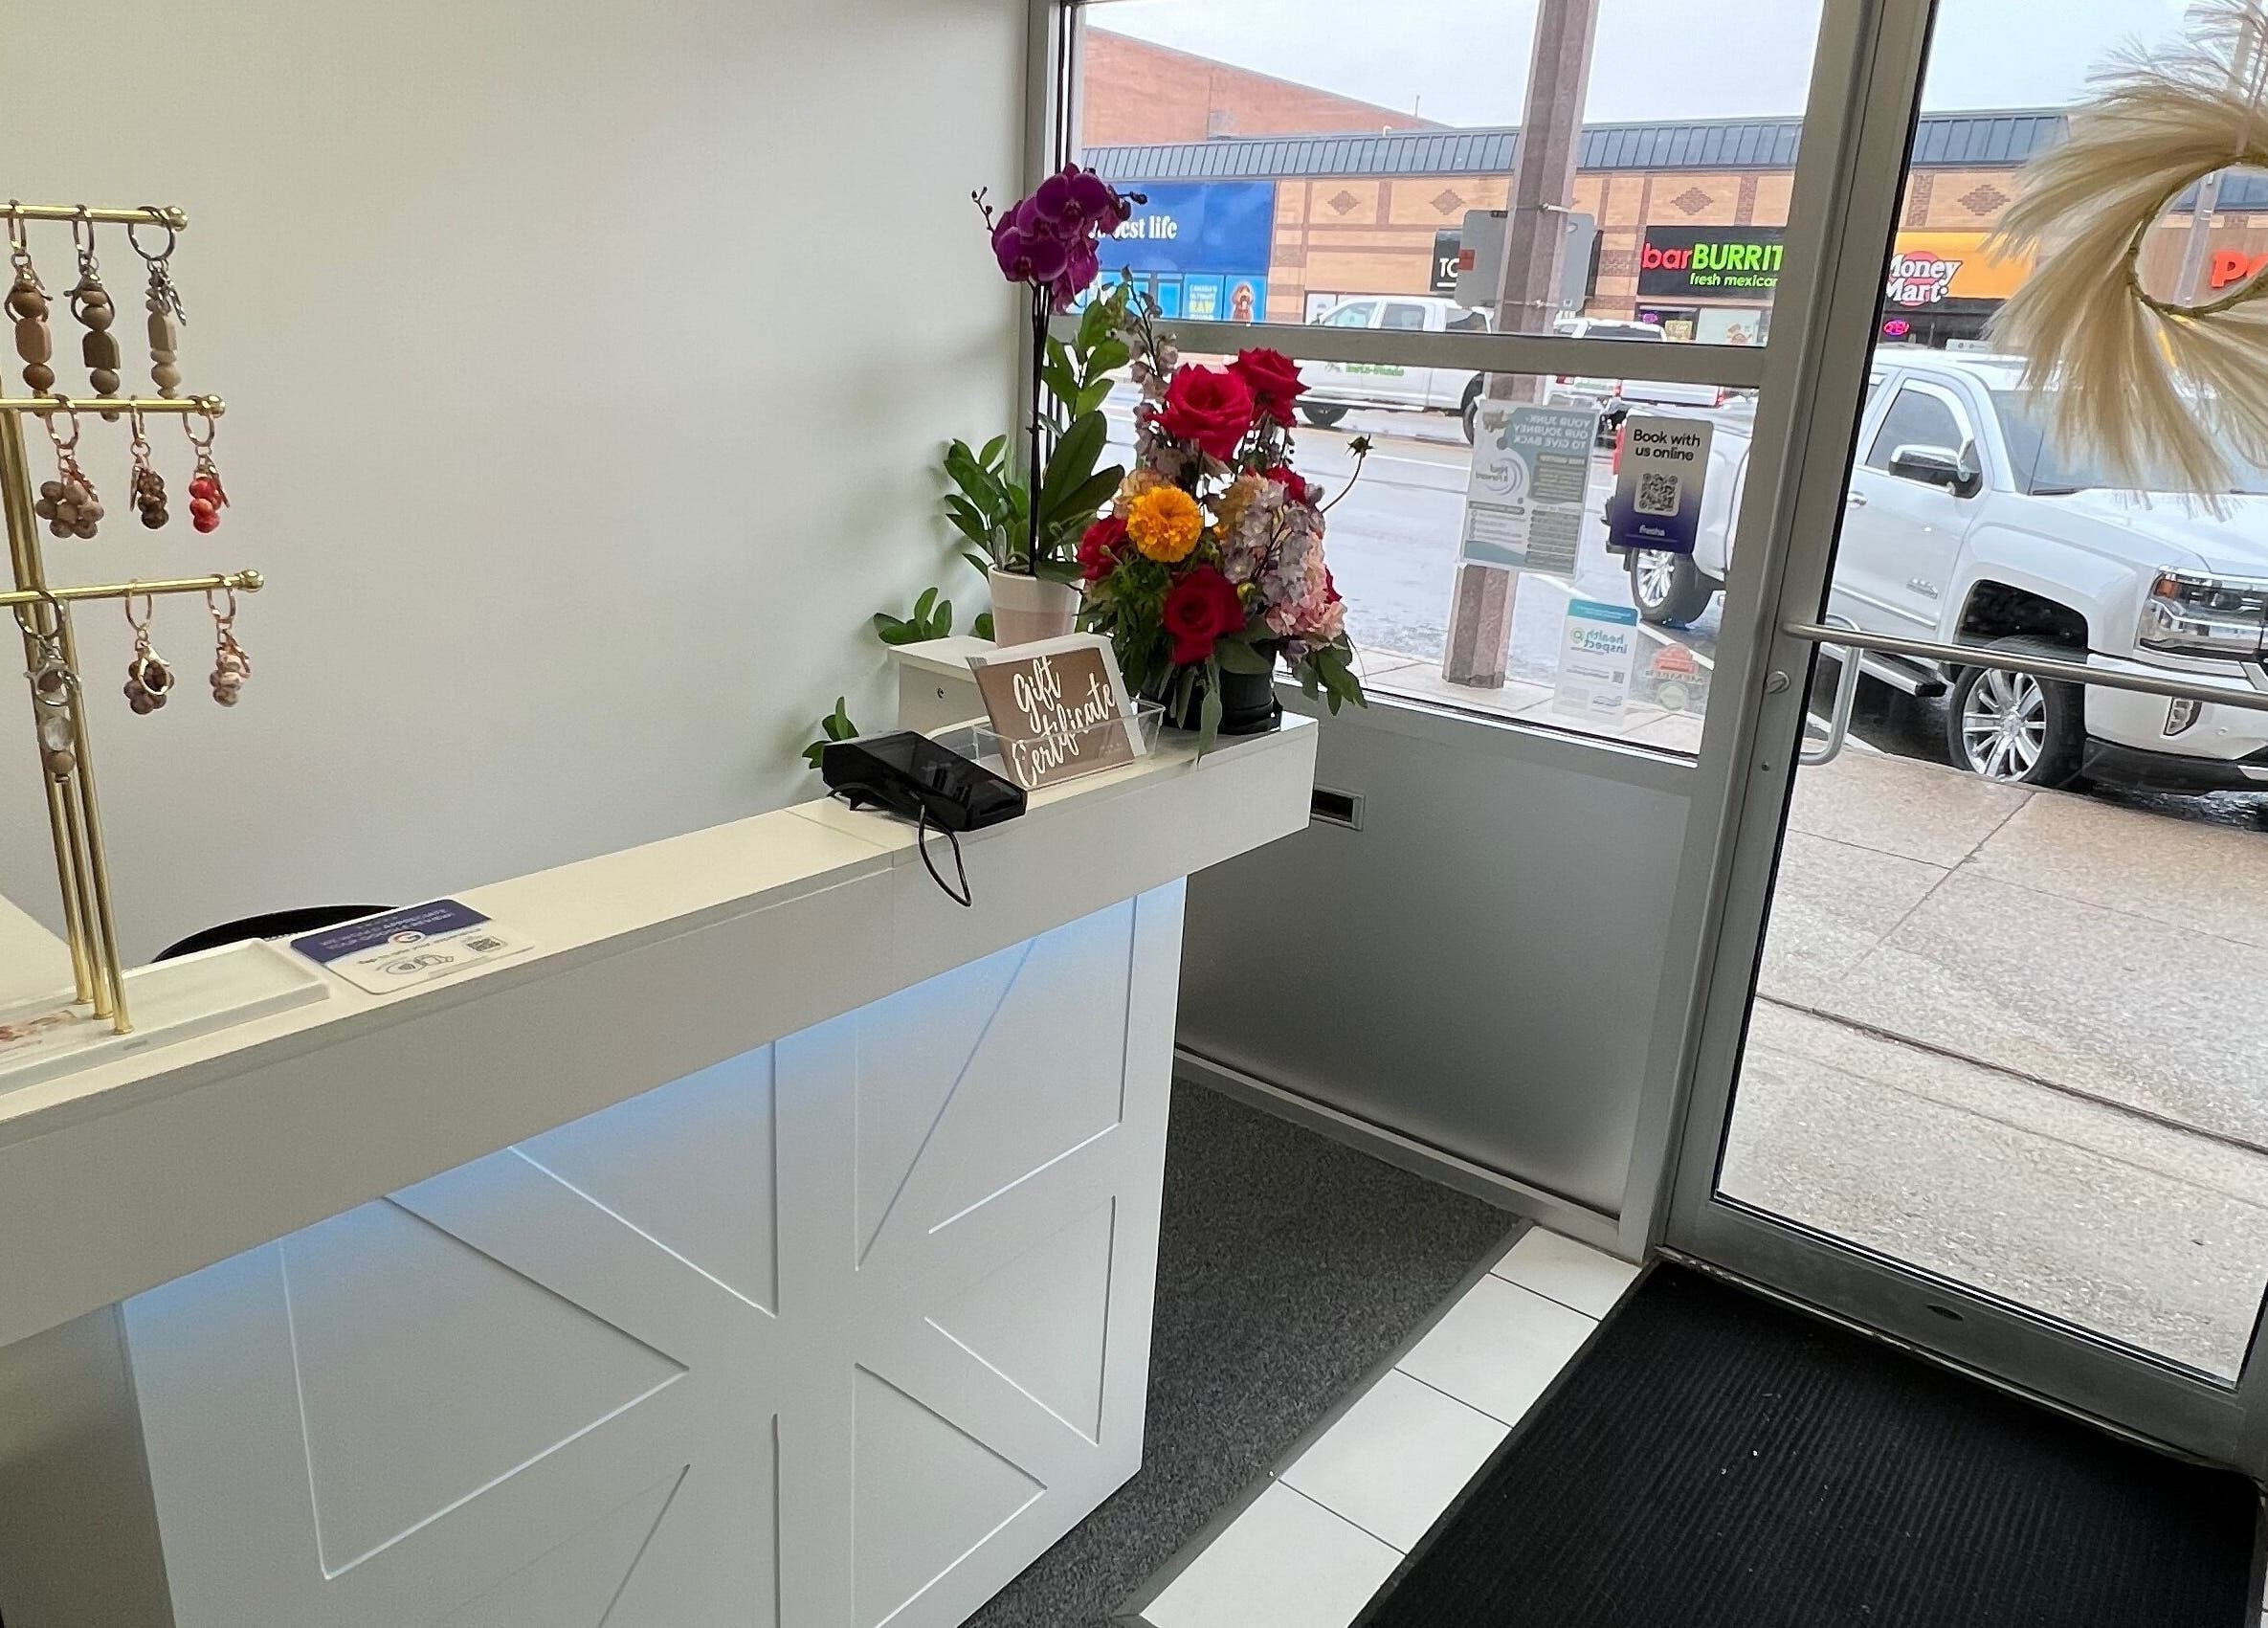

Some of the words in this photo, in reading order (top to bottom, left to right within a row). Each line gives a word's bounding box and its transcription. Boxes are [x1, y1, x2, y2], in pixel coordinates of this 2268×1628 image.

[1148, 214, 1178, 239] life
[1689, 273, 1721, 287] fresh
[1634, 429, 1668, 444] Book
[1670, 433, 1701, 447] with
[1635, 447, 1651, 457] us
[1653, 446, 1694, 461] online
